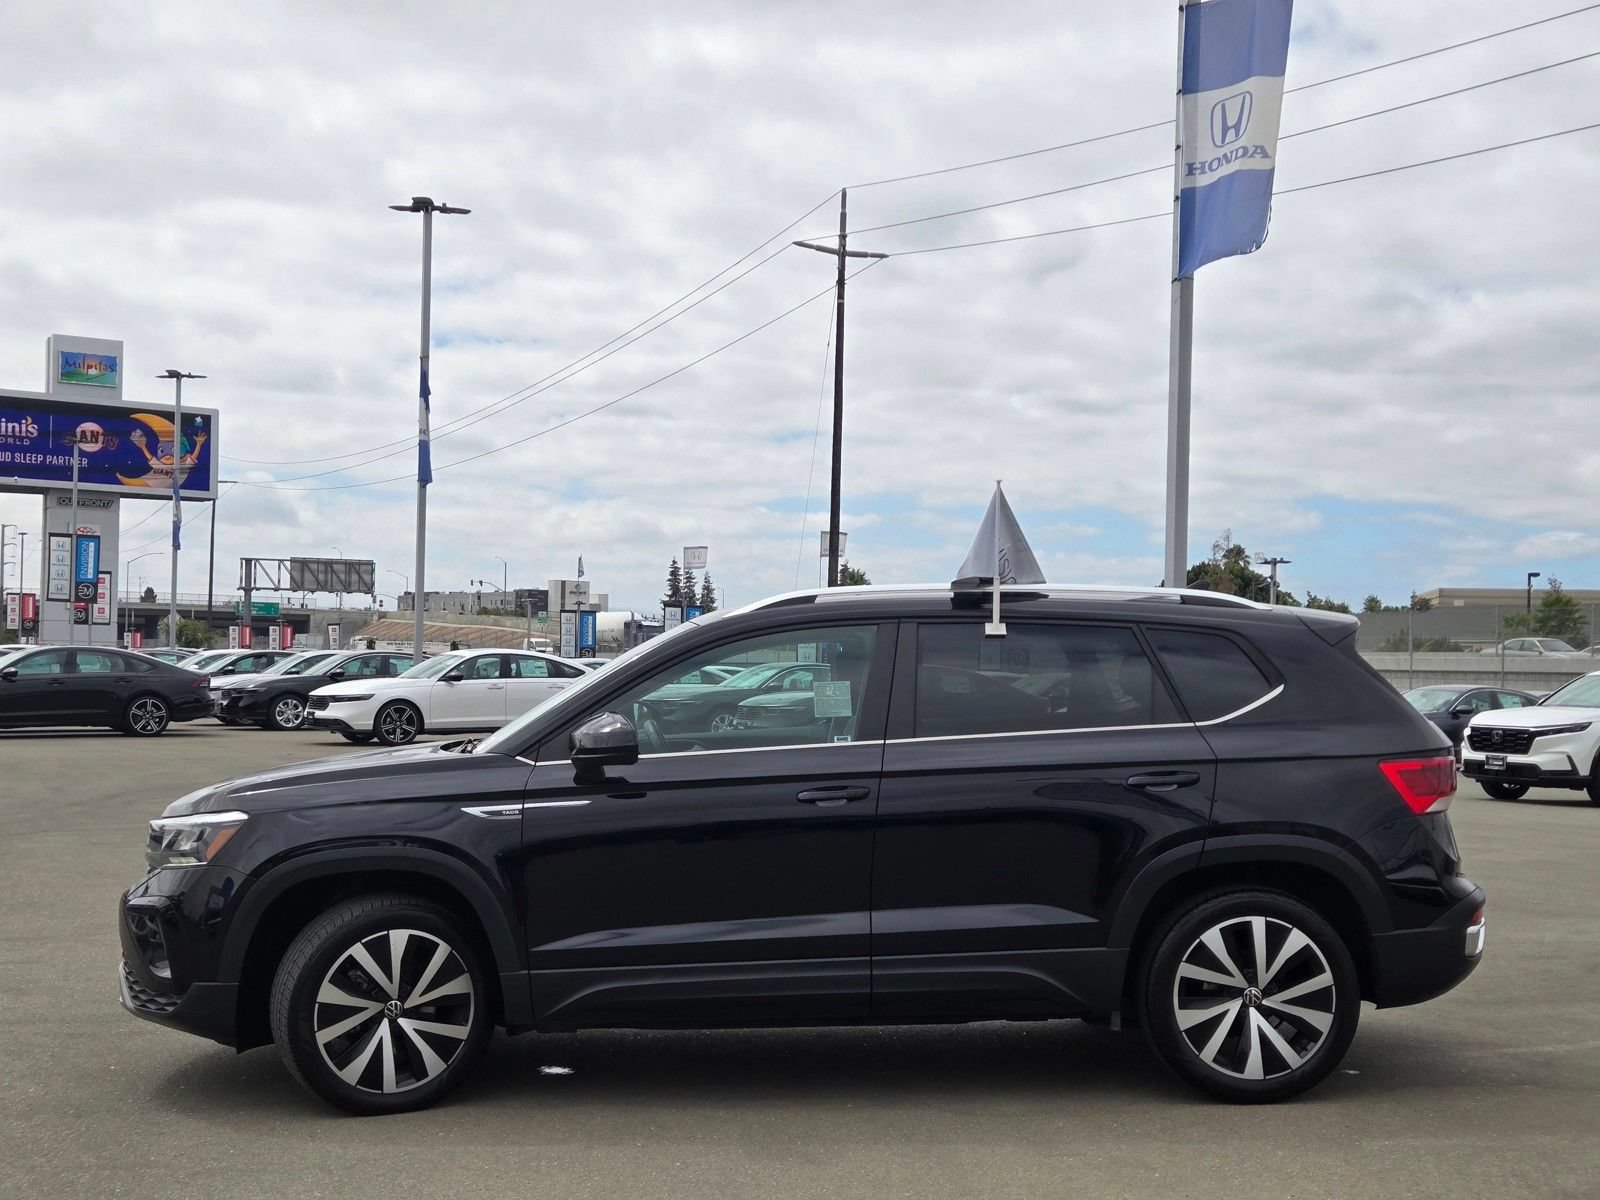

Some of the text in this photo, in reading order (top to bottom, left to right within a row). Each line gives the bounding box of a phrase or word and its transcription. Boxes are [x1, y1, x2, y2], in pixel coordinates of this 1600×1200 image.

[1185, 144, 1272, 177] HONDA
[62, 355, 115, 375] Milpitas
[14, 453, 43, 464] SLEEP
[80, 541, 89, 579] ENVISION
